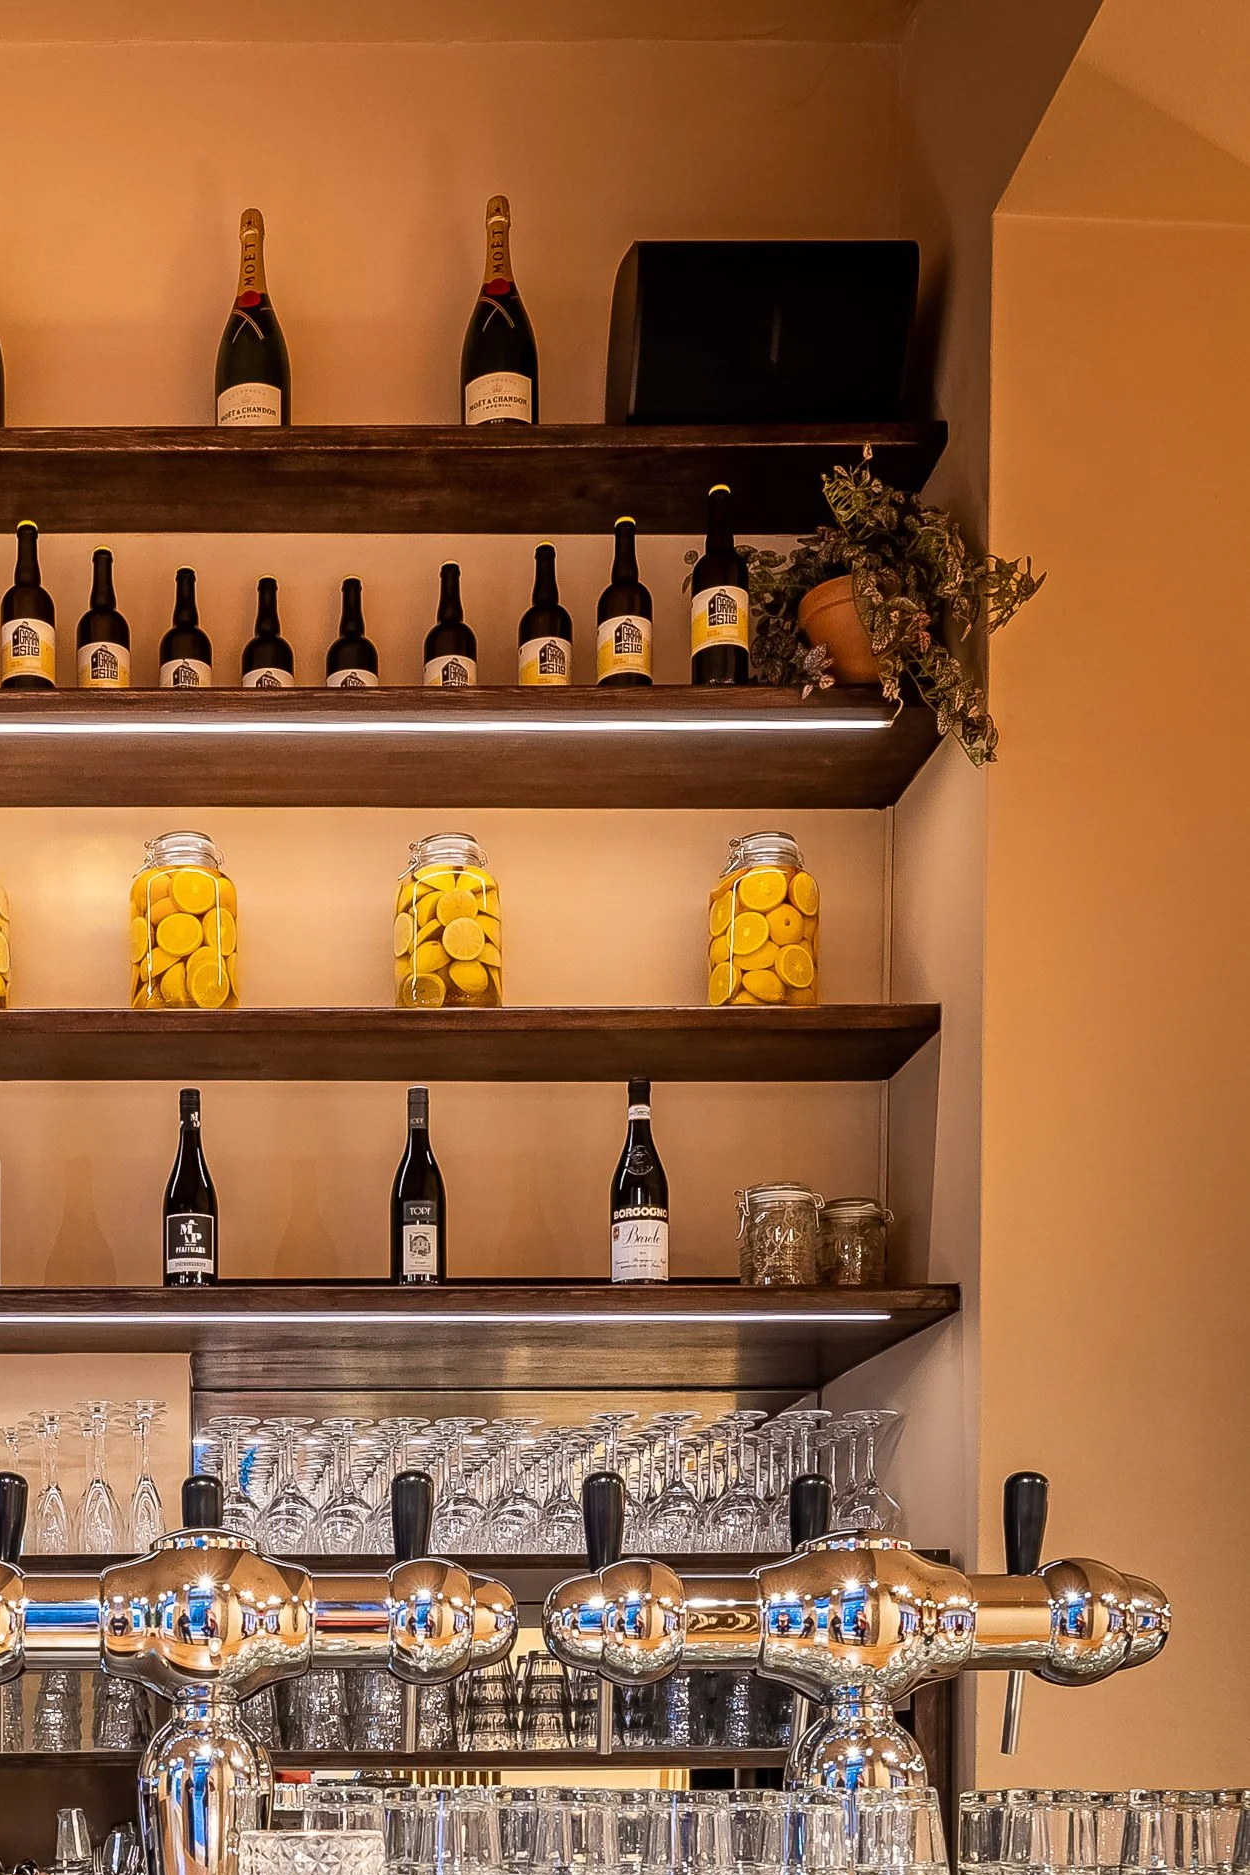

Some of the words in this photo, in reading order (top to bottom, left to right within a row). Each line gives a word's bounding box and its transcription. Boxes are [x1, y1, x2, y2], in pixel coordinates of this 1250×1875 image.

[492, 396, 527, 406] CHANDON
[241, 406, 276, 416] CHANDON
[717, 614, 738, 625] SILO
[19, 646, 40, 657] SILO
[623, 643, 643, 654] SILO
[98, 669, 119, 679] SILO
[547, 664, 565, 674] SILO
[613, 1207, 668, 1220] BORGOGNO
[622, 1224, 661, 1245] Barolo
